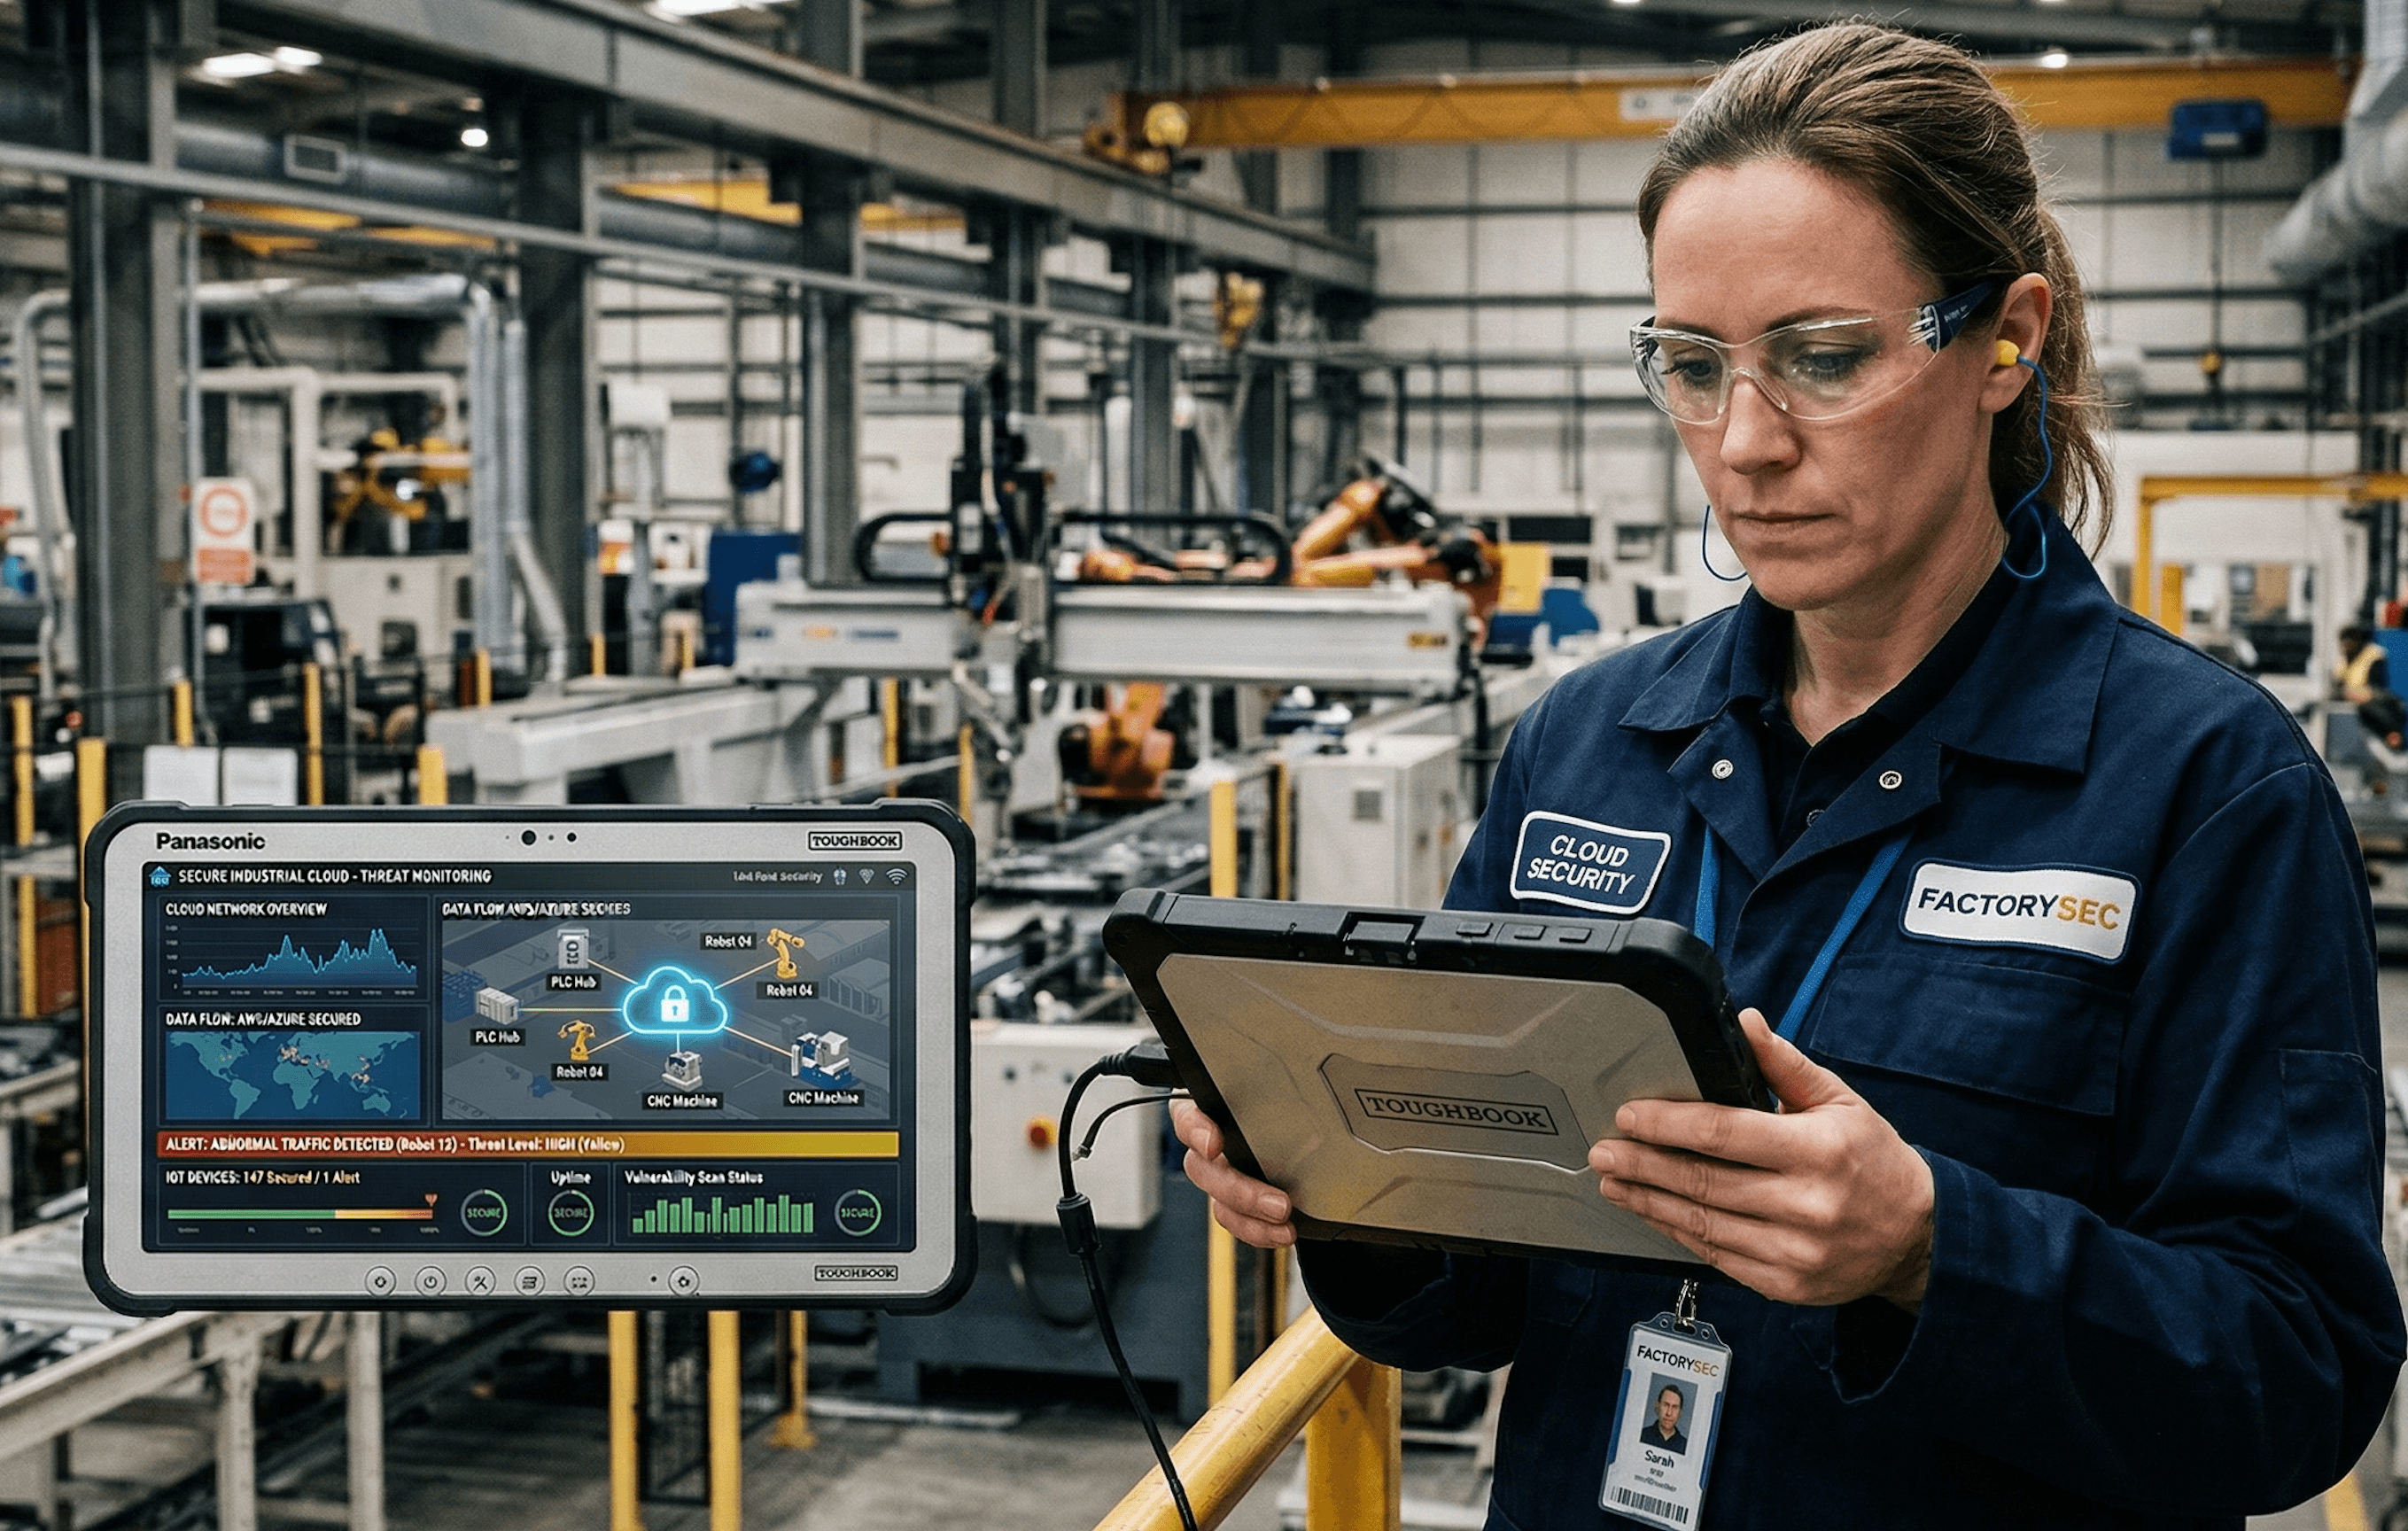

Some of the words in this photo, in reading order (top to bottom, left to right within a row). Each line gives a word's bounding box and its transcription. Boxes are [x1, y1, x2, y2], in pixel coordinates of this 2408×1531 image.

[156, 833, 265, 850] Panasonic
[812, 835, 897, 847] TOUGHBOOK
[1550, 835, 1629, 867] CLOUD
[178, 869, 227, 883] SECURE
[230, 869, 305, 883] INDUSTRIAL
[307, 869, 349, 883] CLOUD
[361, 869, 409, 883] THREAT
[1526, 857, 1636, 895] SECURITY
[166, 902, 205, 916] CLOUD
[206, 902, 265, 916] NETWORK
[266, 902, 328, 916] OVERVIEW
[1918, 888, 2121, 930] FACTORYSEC
[551, 975, 572, 988] PLC
[166, 1012, 197, 1026] DATA
[308, 1012, 361, 1026] SECURED
[476, 1030, 496, 1043] PLC
[648, 1094, 671, 1107] CNC
[788, 1092, 812, 1105] CNC
[1365, 1096, 1548, 1128] TOUGHBOOK
[166, 1137, 208, 1151] ALERT:
[281, 1137, 330, 1151] TRAFFIC
[333, 1137, 394, 1151] DETECTED
[1636, 1345, 1720, 1377] FACTORYSEC
[1644, 1449, 1674, 1468] Sarah
